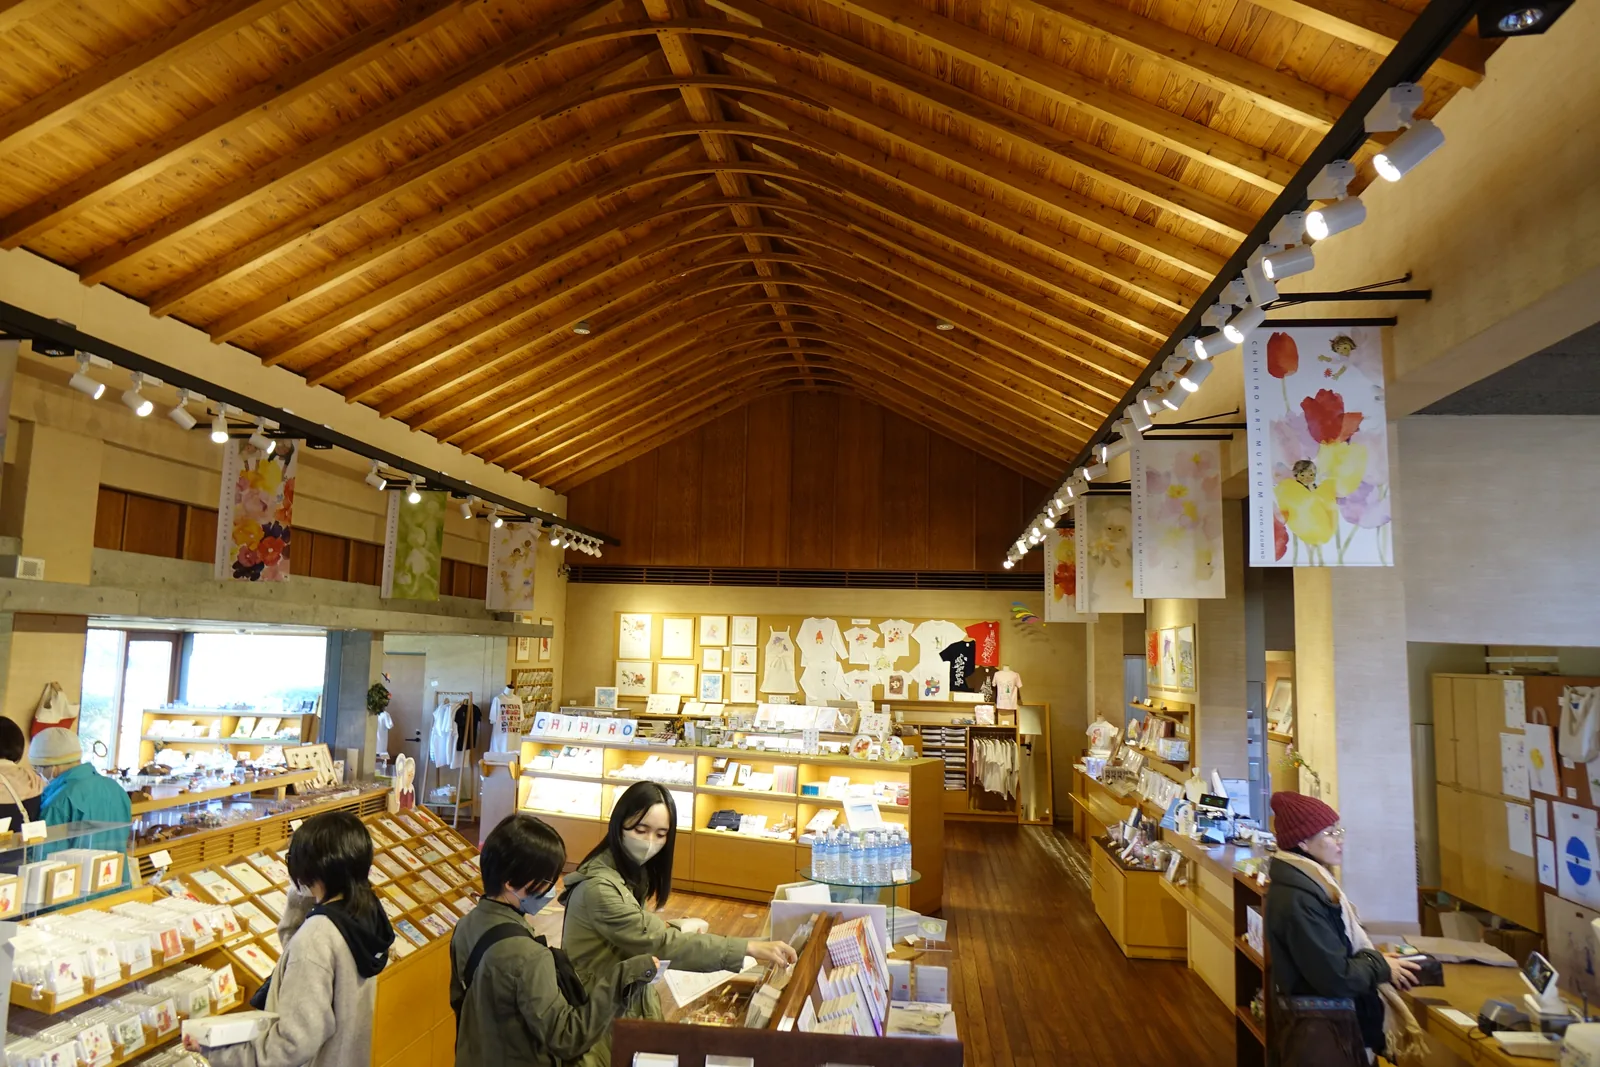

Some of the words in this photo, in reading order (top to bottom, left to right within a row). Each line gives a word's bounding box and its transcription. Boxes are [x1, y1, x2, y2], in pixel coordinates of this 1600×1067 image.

[1252, 340, 1260, 400] CHIHIRO
[1255, 440, 1263, 498] MUSEUM
[537, 718, 632, 735] CHIHIRO
